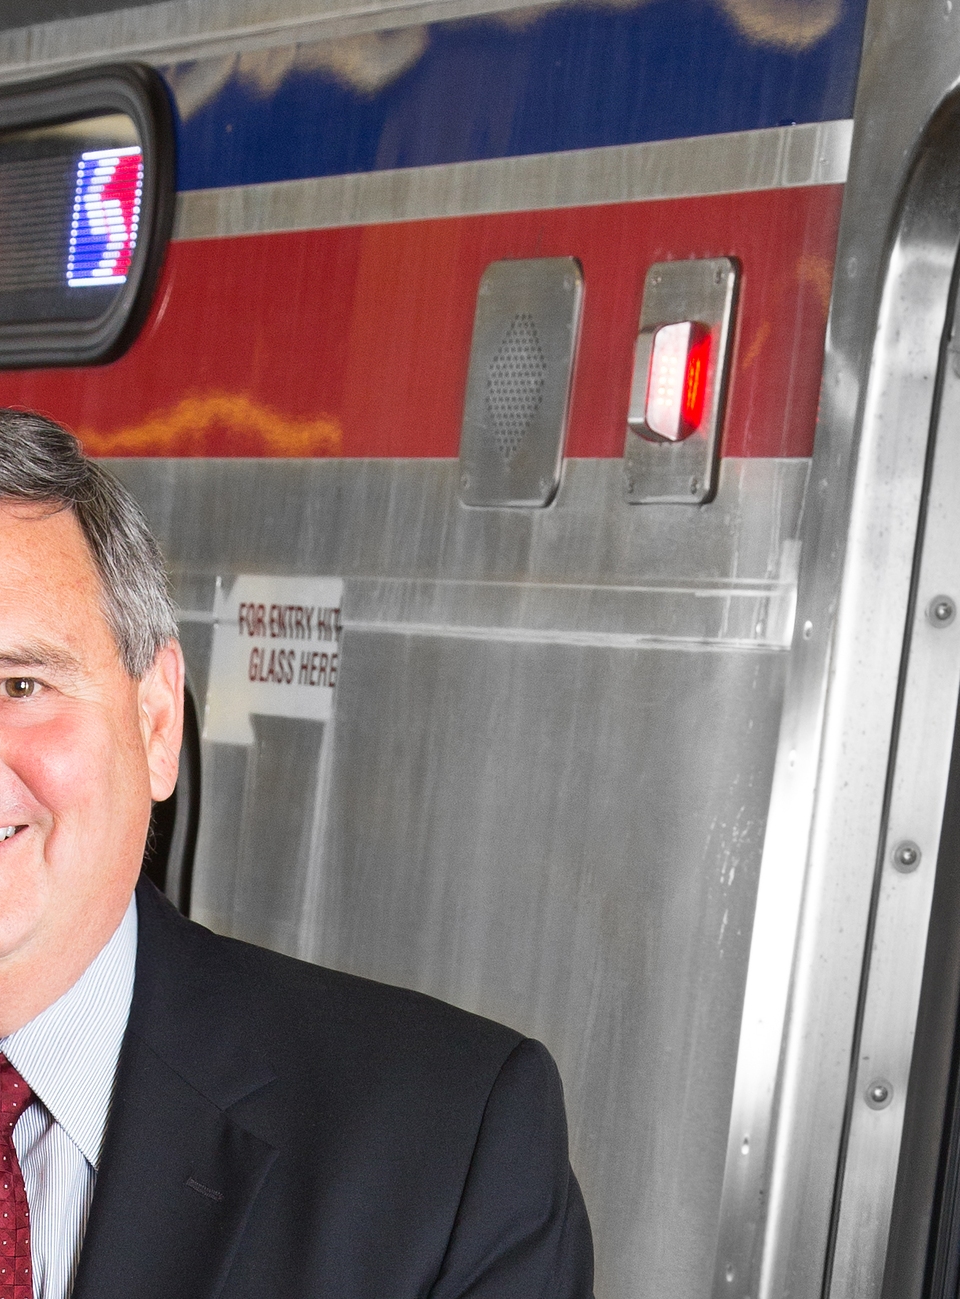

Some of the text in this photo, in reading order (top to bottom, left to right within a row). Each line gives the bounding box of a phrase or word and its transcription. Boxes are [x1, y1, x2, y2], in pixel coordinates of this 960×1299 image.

[239, 602, 267, 638] FOR
[269, 604, 315, 641] ENTRY
[248, 646, 339, 688] GLASS HERE
